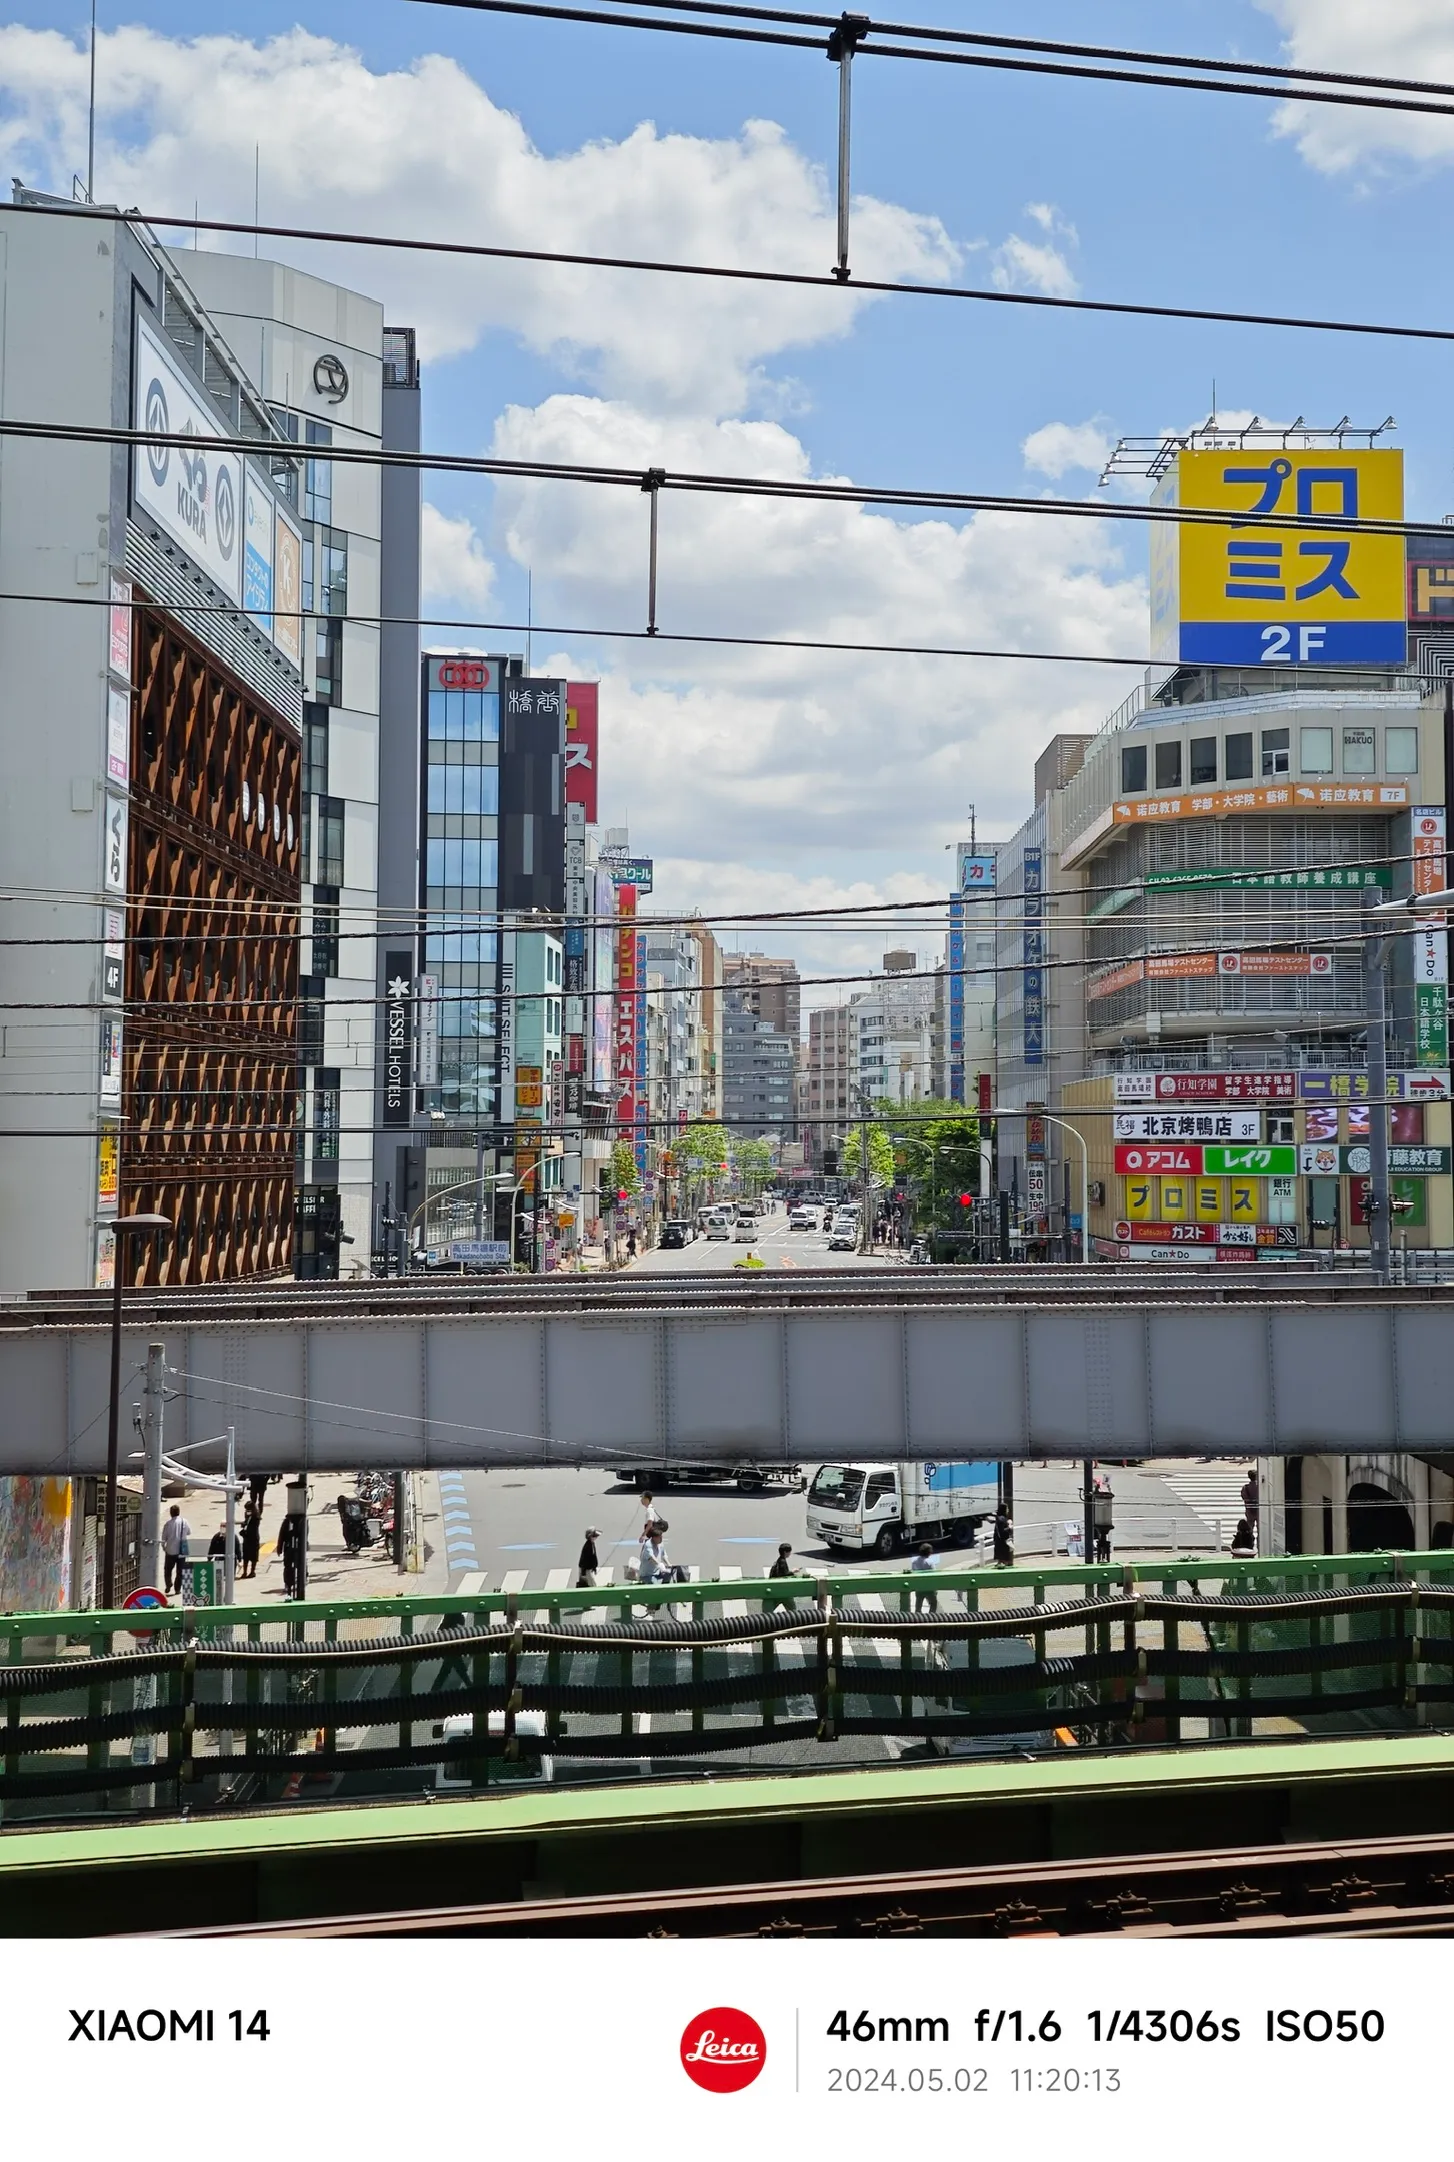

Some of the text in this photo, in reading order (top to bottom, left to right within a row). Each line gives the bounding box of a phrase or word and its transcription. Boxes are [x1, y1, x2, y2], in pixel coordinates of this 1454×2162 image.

[1223, 458, 1359, 529] プロ
[178, 482, 207, 545] KURA
[1225, 541, 1361, 601] ミス
[1260, 625, 1327, 661] 2F
[1387, 791, 1400, 800] 7F
[1025, 852, 1041, 862] B1F
[107, 965, 119, 989] 4F
[388, 1002, 404, 1108] VESSEL HOTELS
[1142, 1116, 1232, 1136] 北京烤鴨店
[1241, 1124, 1256, 1136] 3F
[1146, 1151, 1191, 1169] アコム
[1223, 1149, 1270, 1168] レイク
[1029, 1178, 1043, 1190] 50
[1273, 1188, 1291, 1197] ATM
[1172, 1225, 1205, 1240] ガスト
[1151, 1249, 1190, 1259] Can Do
